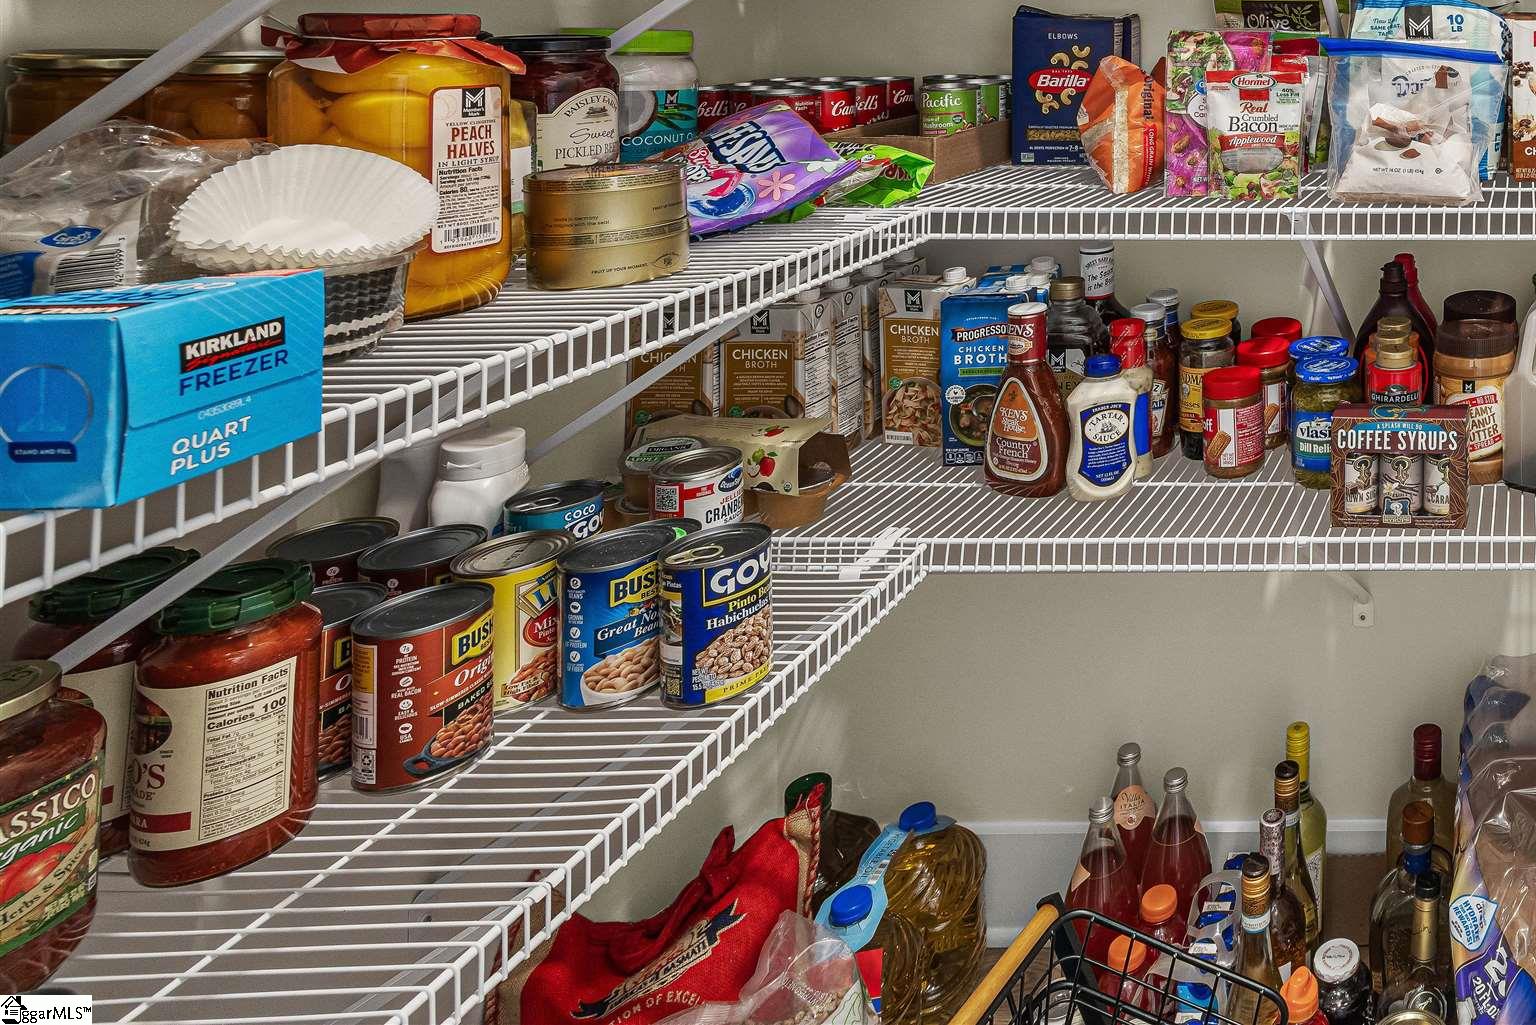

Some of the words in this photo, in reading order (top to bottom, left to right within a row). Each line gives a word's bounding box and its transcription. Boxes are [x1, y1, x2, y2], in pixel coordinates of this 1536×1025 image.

[1247, 14, 1289, 31] Olive
[1446, 14, 1464, 26] 10
[1048, 32, 1079, 40] ELBOWS
[1037, 75, 1088, 87] Barilla
[1236, 76, 1271, 87] Hormel
[922, 93, 962, 107] Pacific
[1141, 76, 1155, 120] Original
[564, 94, 601, 118] PAISLEY
[1240, 102, 1268, 114] Real
[1228, 117, 1277, 133] Bacon
[1242, 114, 1279, 122] Crumbled
[451, 125, 492, 142] PEACH
[570, 128, 615, 144] Sweet
[621, 133, 686, 146] COCONUT
[1228, 136, 1277, 145] Applewood
[447, 141, 495, 159] HALVES
[555, 145, 602, 160] PICKLED
[439, 168, 467, 176] Nutrition
[890, 324, 939, 336] CHICKEN
[956, 324, 1008, 341] PROGRESSO
[185, 322, 282, 360] KIRKLAND
[901, 335, 930, 344] BROTH
[732, 349, 788, 360] CHICKEN
[958, 345, 1004, 353] CHICKEN
[745, 360, 778, 369] BROTH
[954, 353, 1007, 365] BROTH
[179, 349, 289, 396] FREEZER
[1371, 392, 1420, 403] GHIRARDELLI
[1000, 407, 1028, 421] KEN'S
[1090, 411, 1123, 426] TARTAR
[171, 416, 251, 455] QUART
[1093, 431, 1121, 441] SAUCE
[1337, 430, 1391, 450] COFFEE
[1397, 430, 1458, 451] SYRUPS
[996, 437, 1031, 450] Country
[1474, 438, 1496, 450] SPREAD
[170, 441, 231, 475] PLUS
[999, 447, 1028, 458] French
[564, 503, 596, 522] COCO
[728, 592, 758, 612] Pinto
[597, 620, 638, 642] Great
[208, 680, 258, 699] Nutrition
[261, 668, 288, 684] Facts
[457, 687, 485, 710] BAKED
[207, 712, 255, 730] Calories
[262, 696, 286, 713] 100
[0, 776, 95, 843] SSICO
[1463, 900, 1480, 942] HYDRATE
[663, 940, 706, 975] BASMATI
